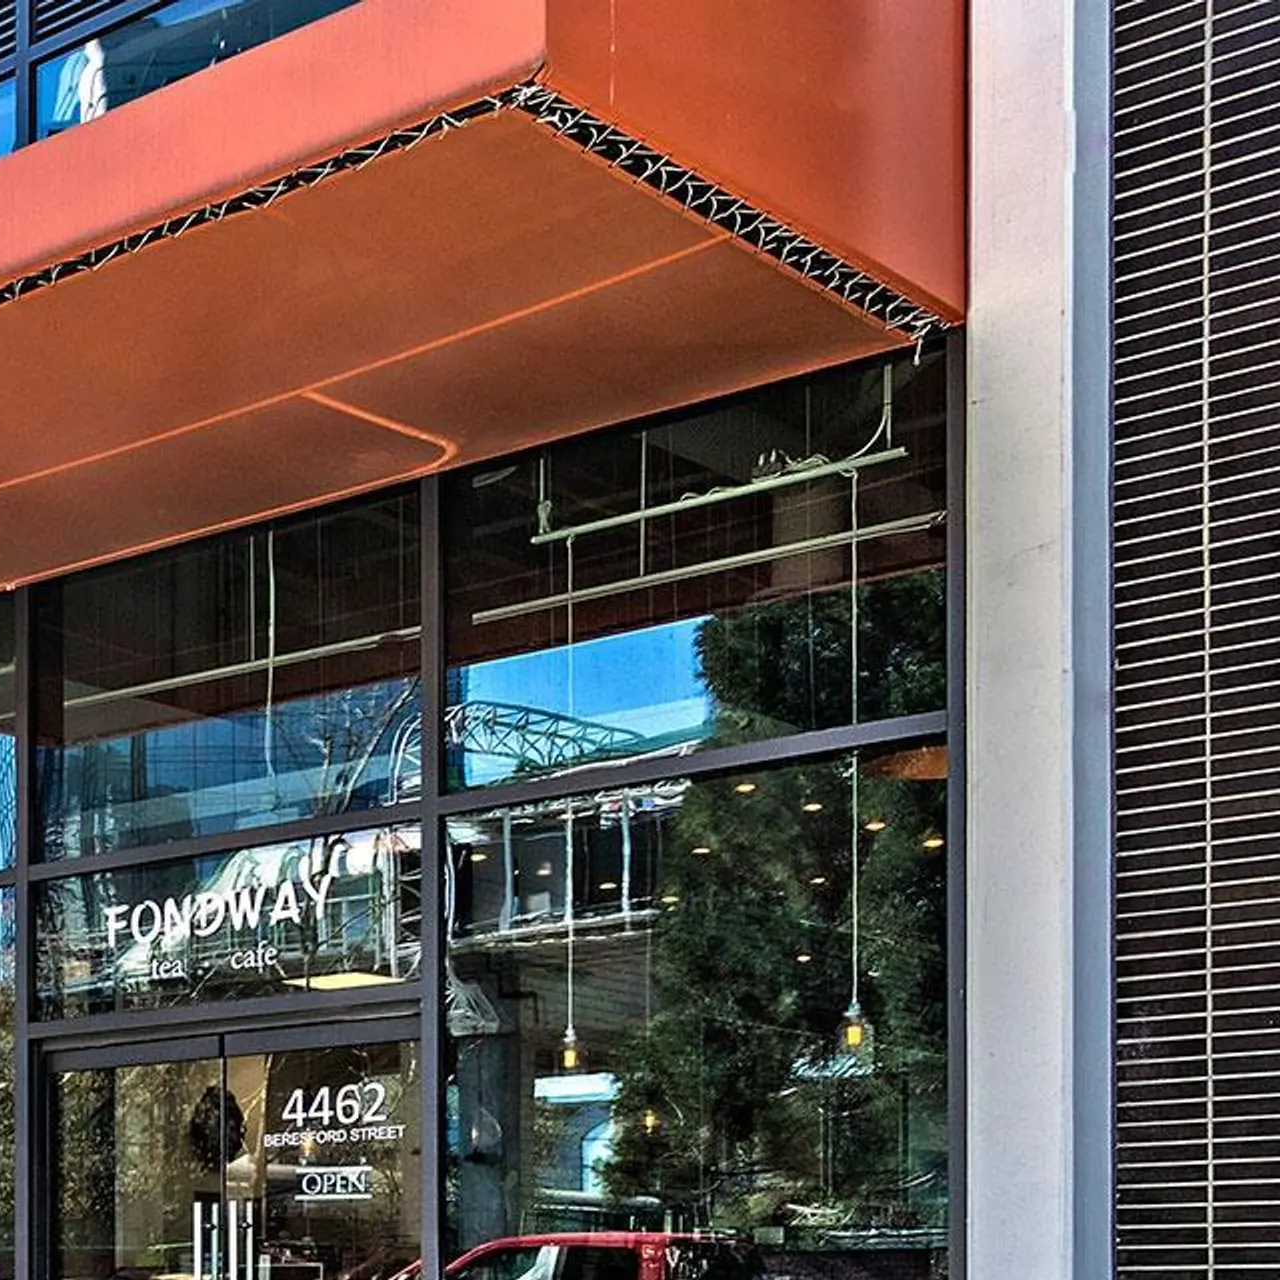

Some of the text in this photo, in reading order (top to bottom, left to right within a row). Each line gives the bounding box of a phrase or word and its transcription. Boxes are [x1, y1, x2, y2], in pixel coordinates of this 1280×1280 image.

[103, 873, 333, 948] FONDWAY
[151, 940, 278, 980] tea cafe
[281, 1081, 388, 1128] 4462
[263, 1125, 407, 1148] BERESFORD STREET
[301, 1172, 366, 1195] OPEN
